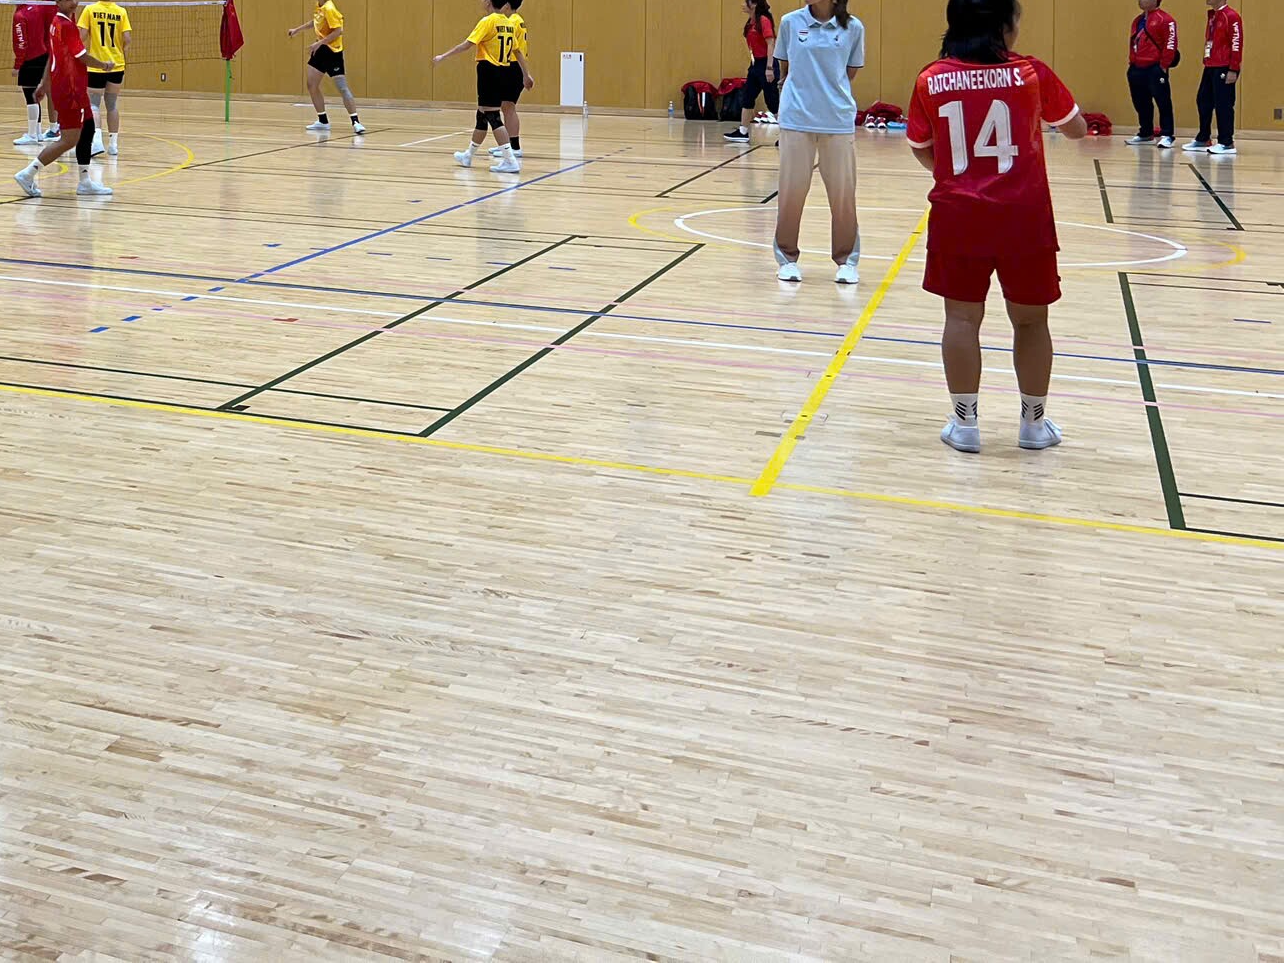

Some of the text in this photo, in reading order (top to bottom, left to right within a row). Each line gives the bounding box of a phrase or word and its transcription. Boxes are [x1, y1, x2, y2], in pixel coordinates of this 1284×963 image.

[107, 13, 121, 21] NAM
[97, 21, 116, 48] 11
[497, 35, 514, 63] 12
[927, 68, 1025, 95] RATCHANEEKORN S.
[938, 99, 1019, 176] 14
